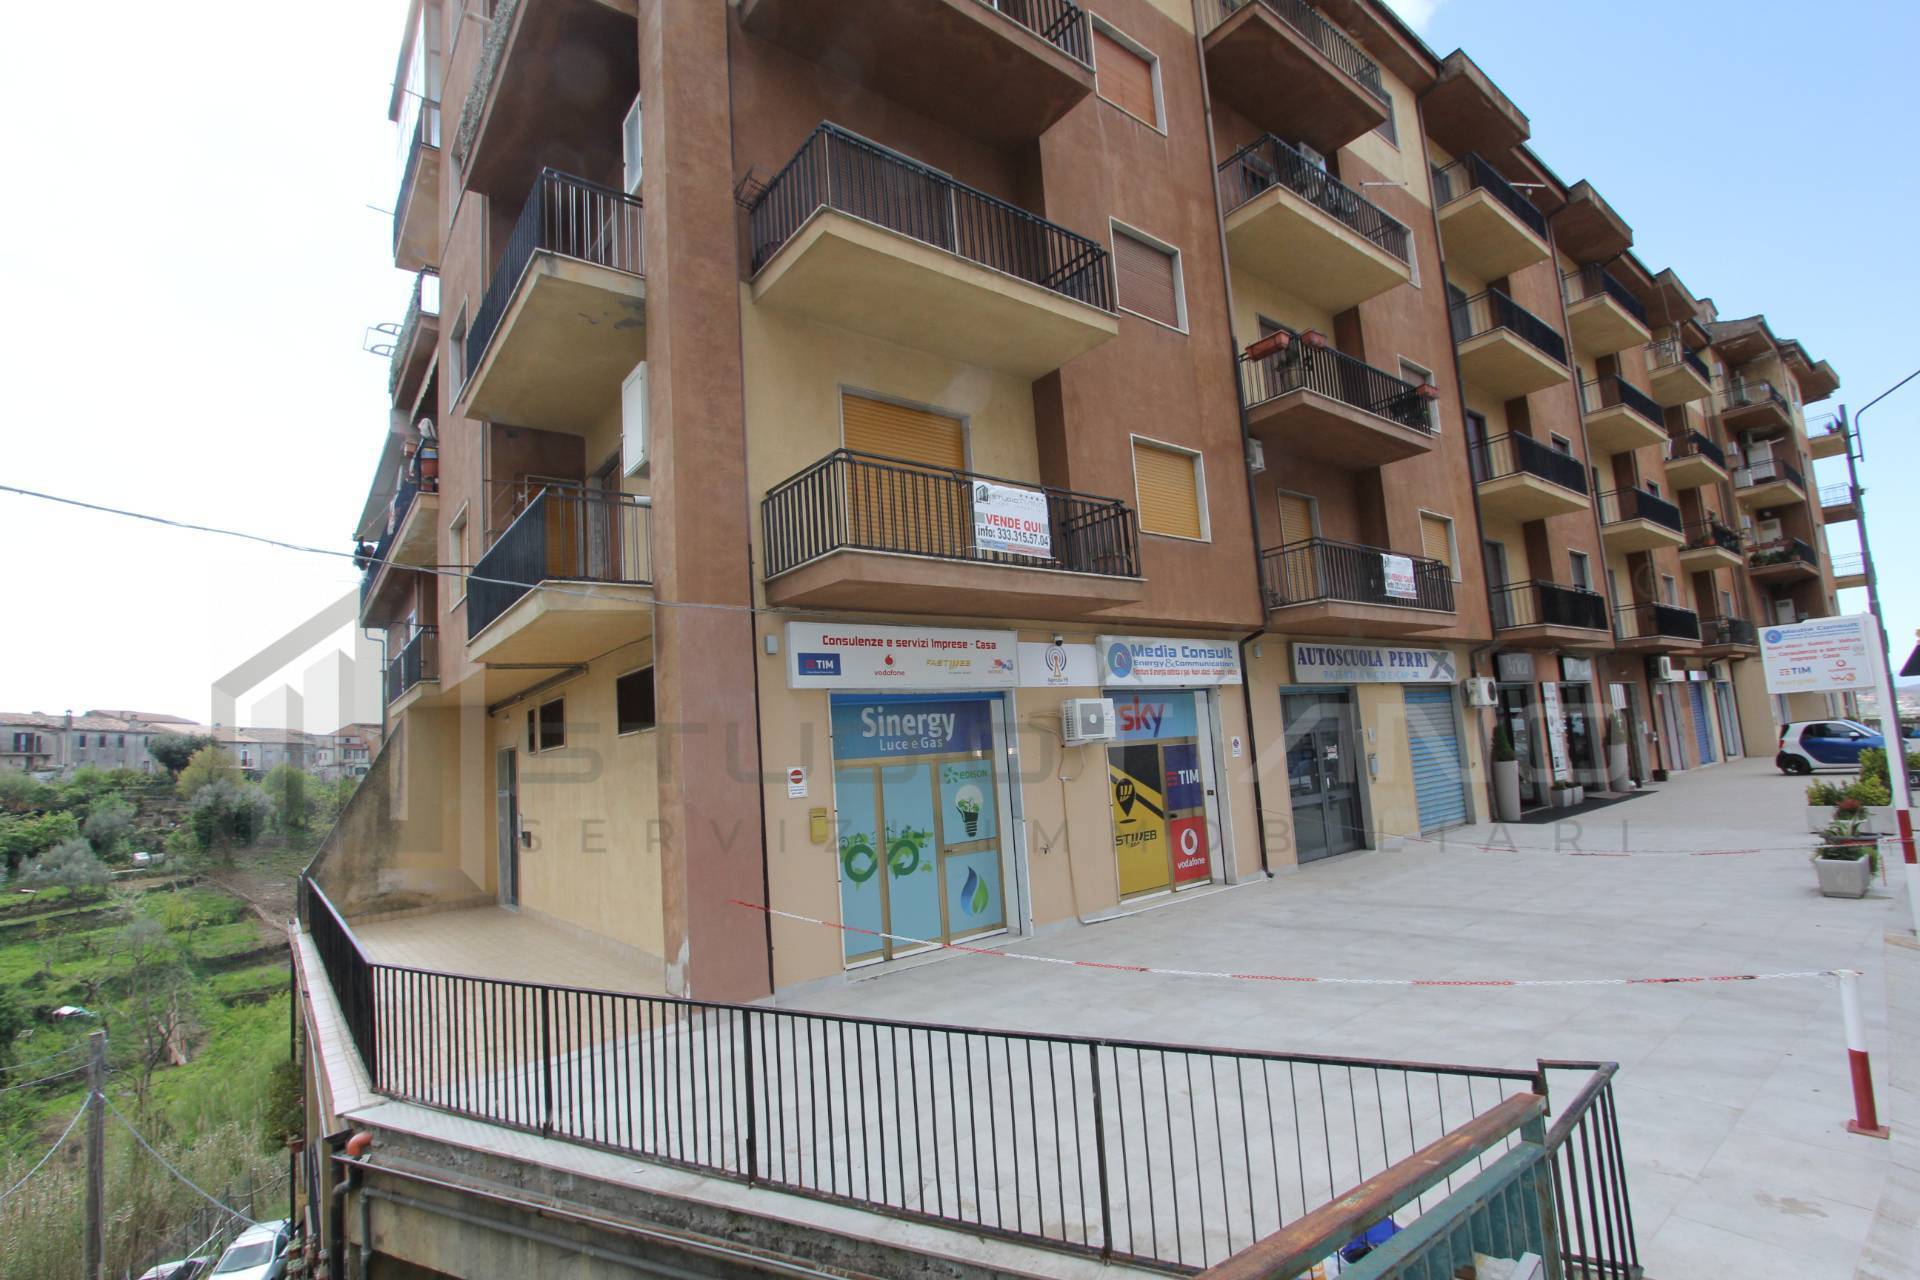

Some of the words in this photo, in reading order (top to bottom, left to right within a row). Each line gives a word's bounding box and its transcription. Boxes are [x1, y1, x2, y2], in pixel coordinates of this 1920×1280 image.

[986, 513, 1021, 529] VENDE
[1023, 520, 1041, 533] QUI
[977, 525, 996, 538] info:
[822, 635, 883, 648] Consulenze
[886, 638, 893, 647] e
[896, 638, 929, 649] servizi
[932, 639, 968, 650] Imprese
[976, 640, 996, 650] Casa
[1130, 644, 1177, 658] Media
[1181, 646, 1233, 659] Consult
[1298, 647, 1383, 667] AUTOSCUOLA
[1388, 652, 1428, 668] PERRI
[816, 659, 834, 669] TIM
[1791, 666, 1812, 675] TIM
[874, 669, 905, 677] vodafone
[861, 706, 956, 741] Sinergy
[1120, 695, 1166, 737] sky
[880, 739, 907, 751] Luce
[911, 741, 918, 749] e
[921, 736, 943, 749] Gas
[1178, 769, 1199, 785] TIM
[1177, 857, 1206, 869] vodafone
